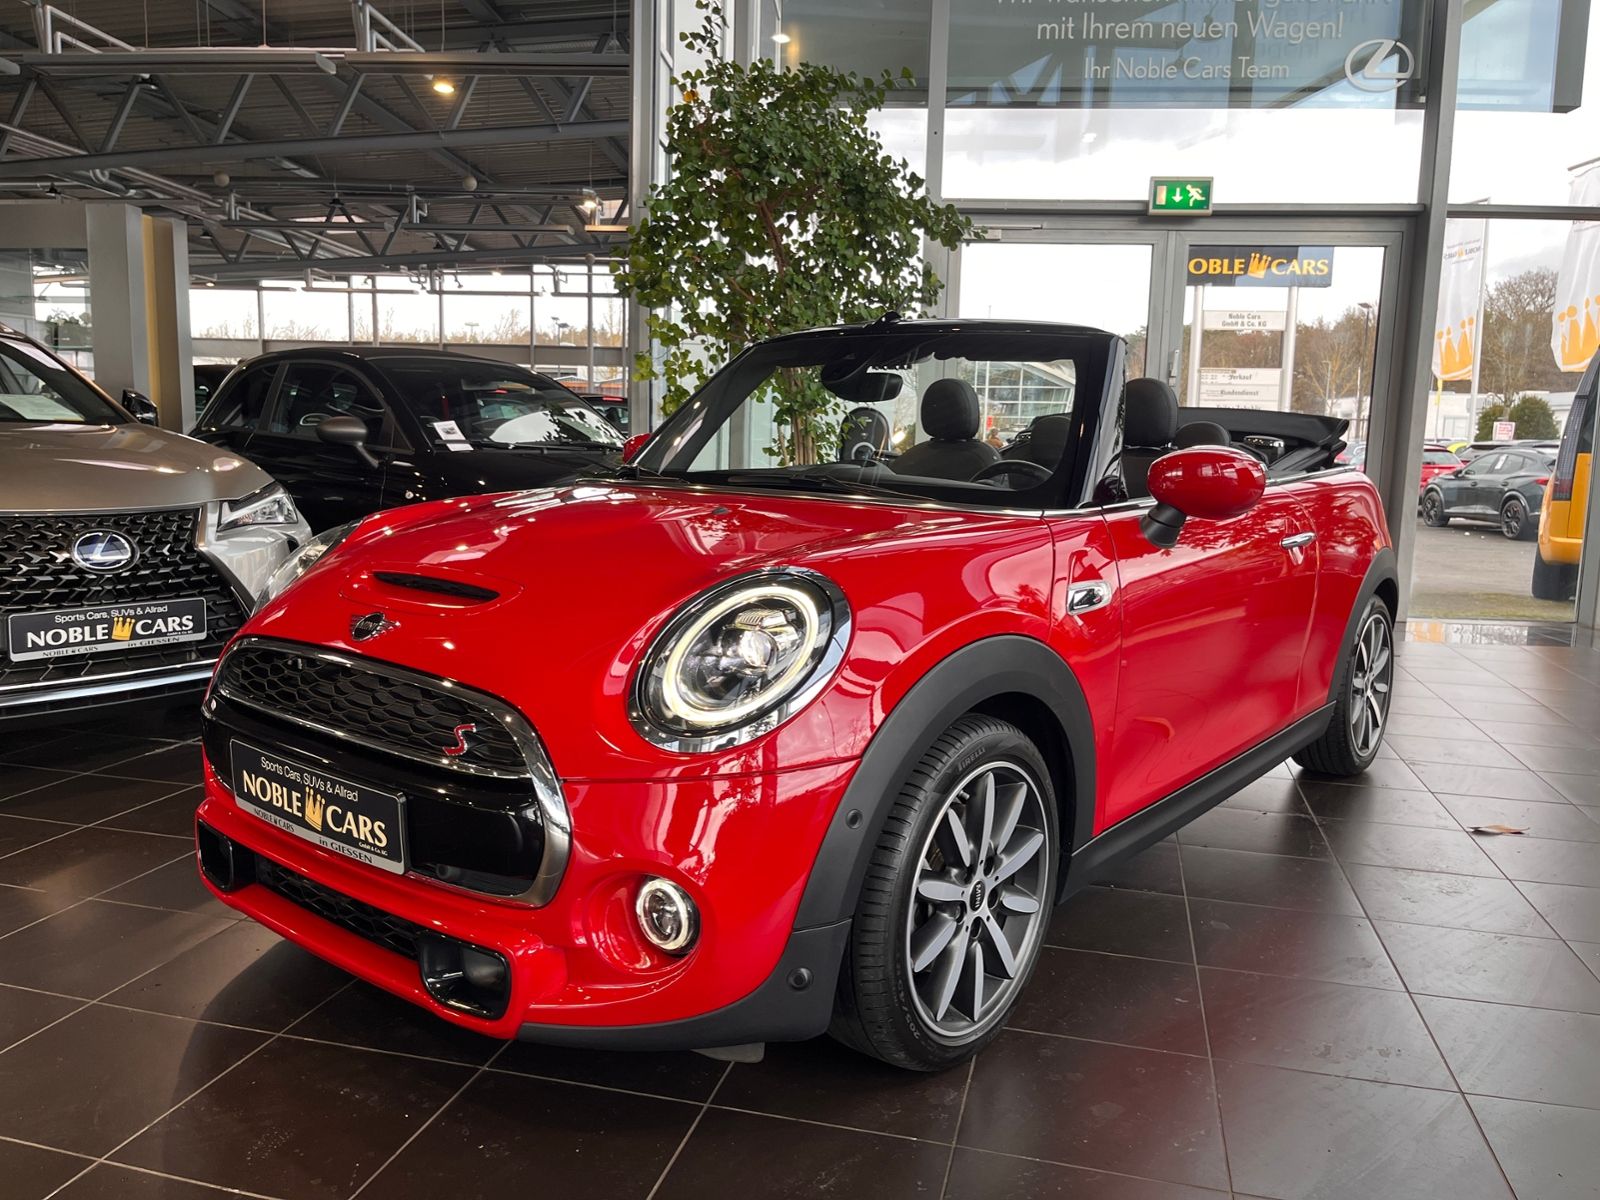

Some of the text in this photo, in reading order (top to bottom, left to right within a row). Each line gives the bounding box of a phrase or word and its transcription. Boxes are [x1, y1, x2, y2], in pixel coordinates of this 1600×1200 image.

[1036, 10, 1344, 45] mit Ihrem neuen Wagen!
[1084, 56, 1290, 79] Ihr Noble Cars Team
[1188, 257, 1329, 276] OBLE CARS
[54, 605, 168, 624] Sports Cars, SUVs & Allrad
[27, 615, 194, 648] NOBLE CARS
[42, 649, 69, 657] NOBLE
[260, 756, 359, 802] Sports Cars, SUVs & Allrad
[242, 769, 388, 848] NOBLE CARS
[253, 808, 295, 833] NOBLE CARS
[319, 836, 373, 864] in GIESSEN
